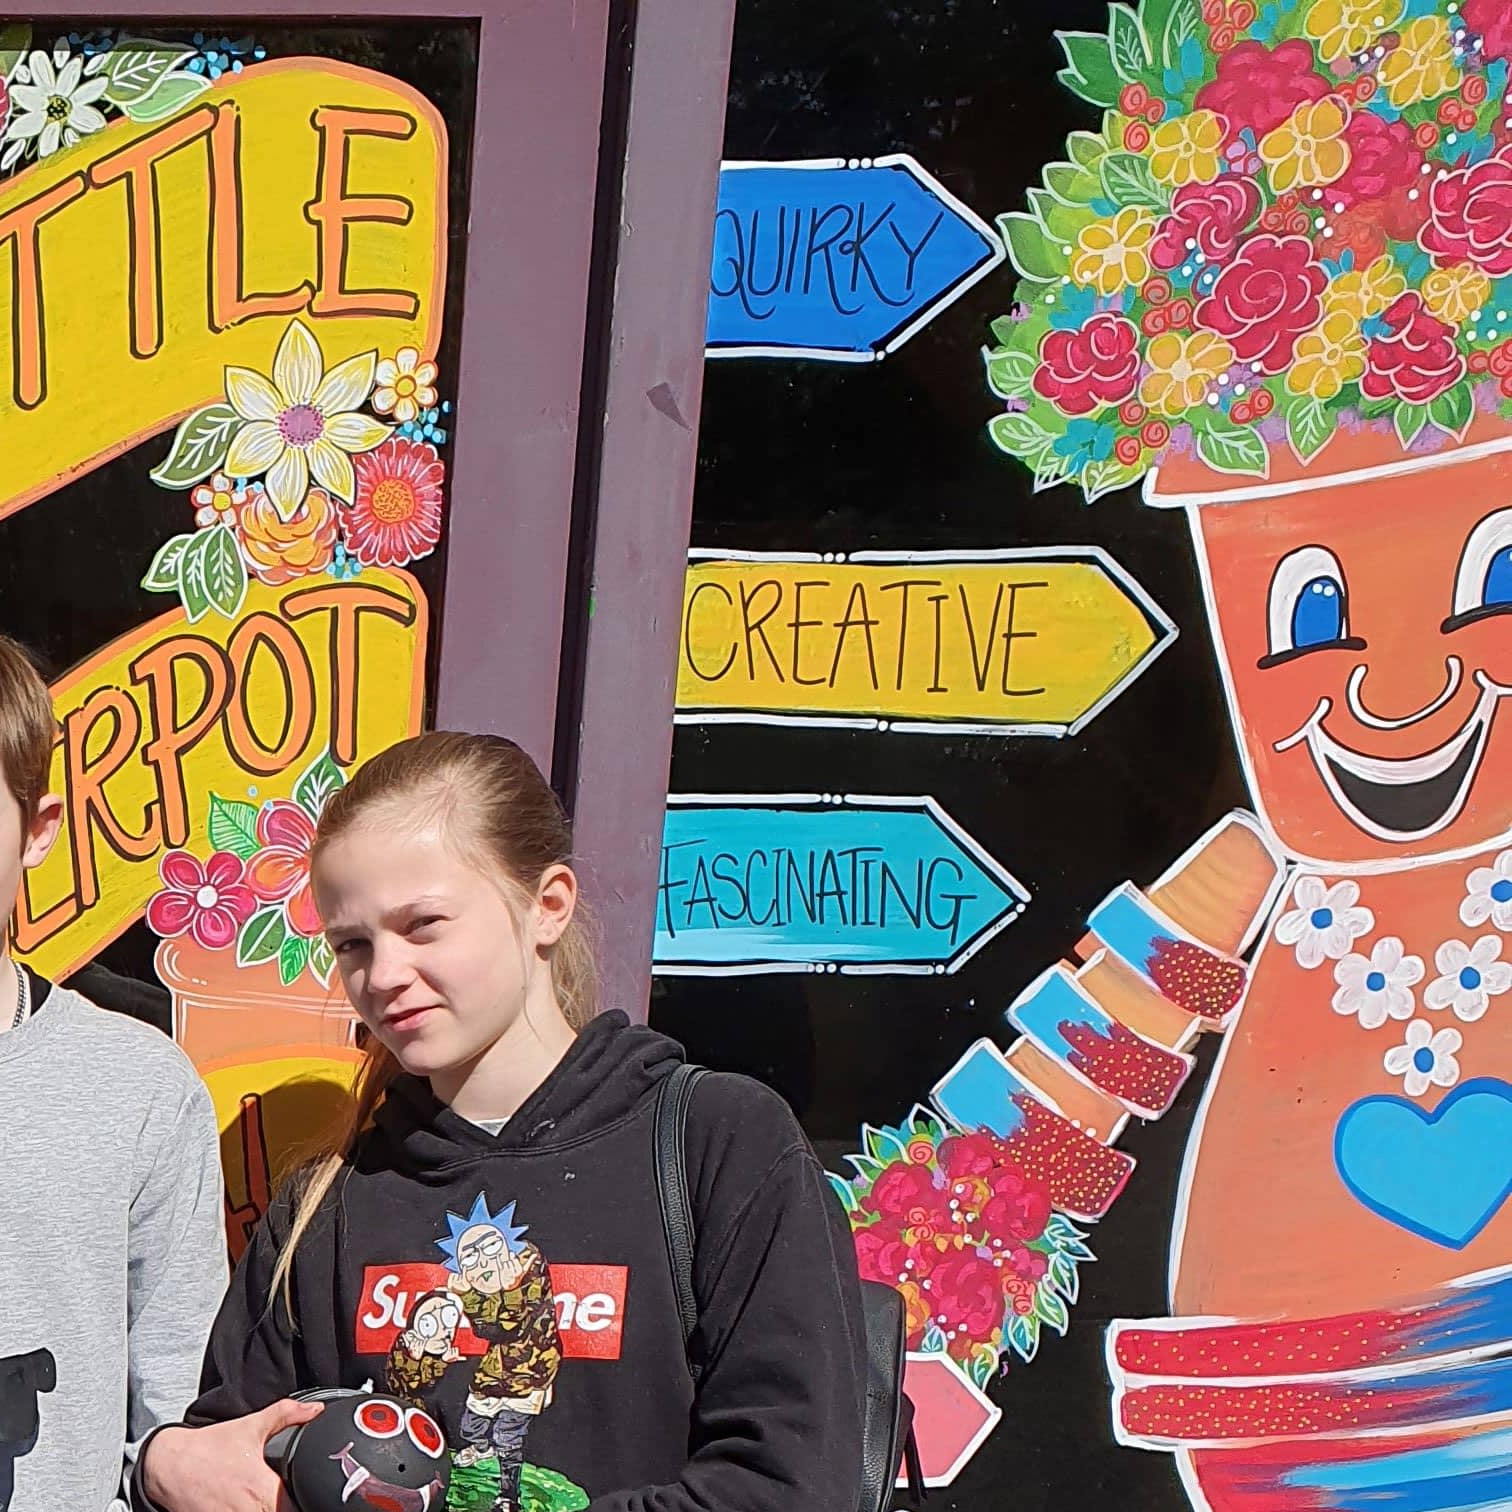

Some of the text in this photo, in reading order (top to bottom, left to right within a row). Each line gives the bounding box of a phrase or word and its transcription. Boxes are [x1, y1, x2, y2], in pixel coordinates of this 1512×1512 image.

[711, 202, 945, 320] QUIRKY
[684, 581, 1050, 697] CREATIVE
[659, 839, 978, 944] FASCINATING
